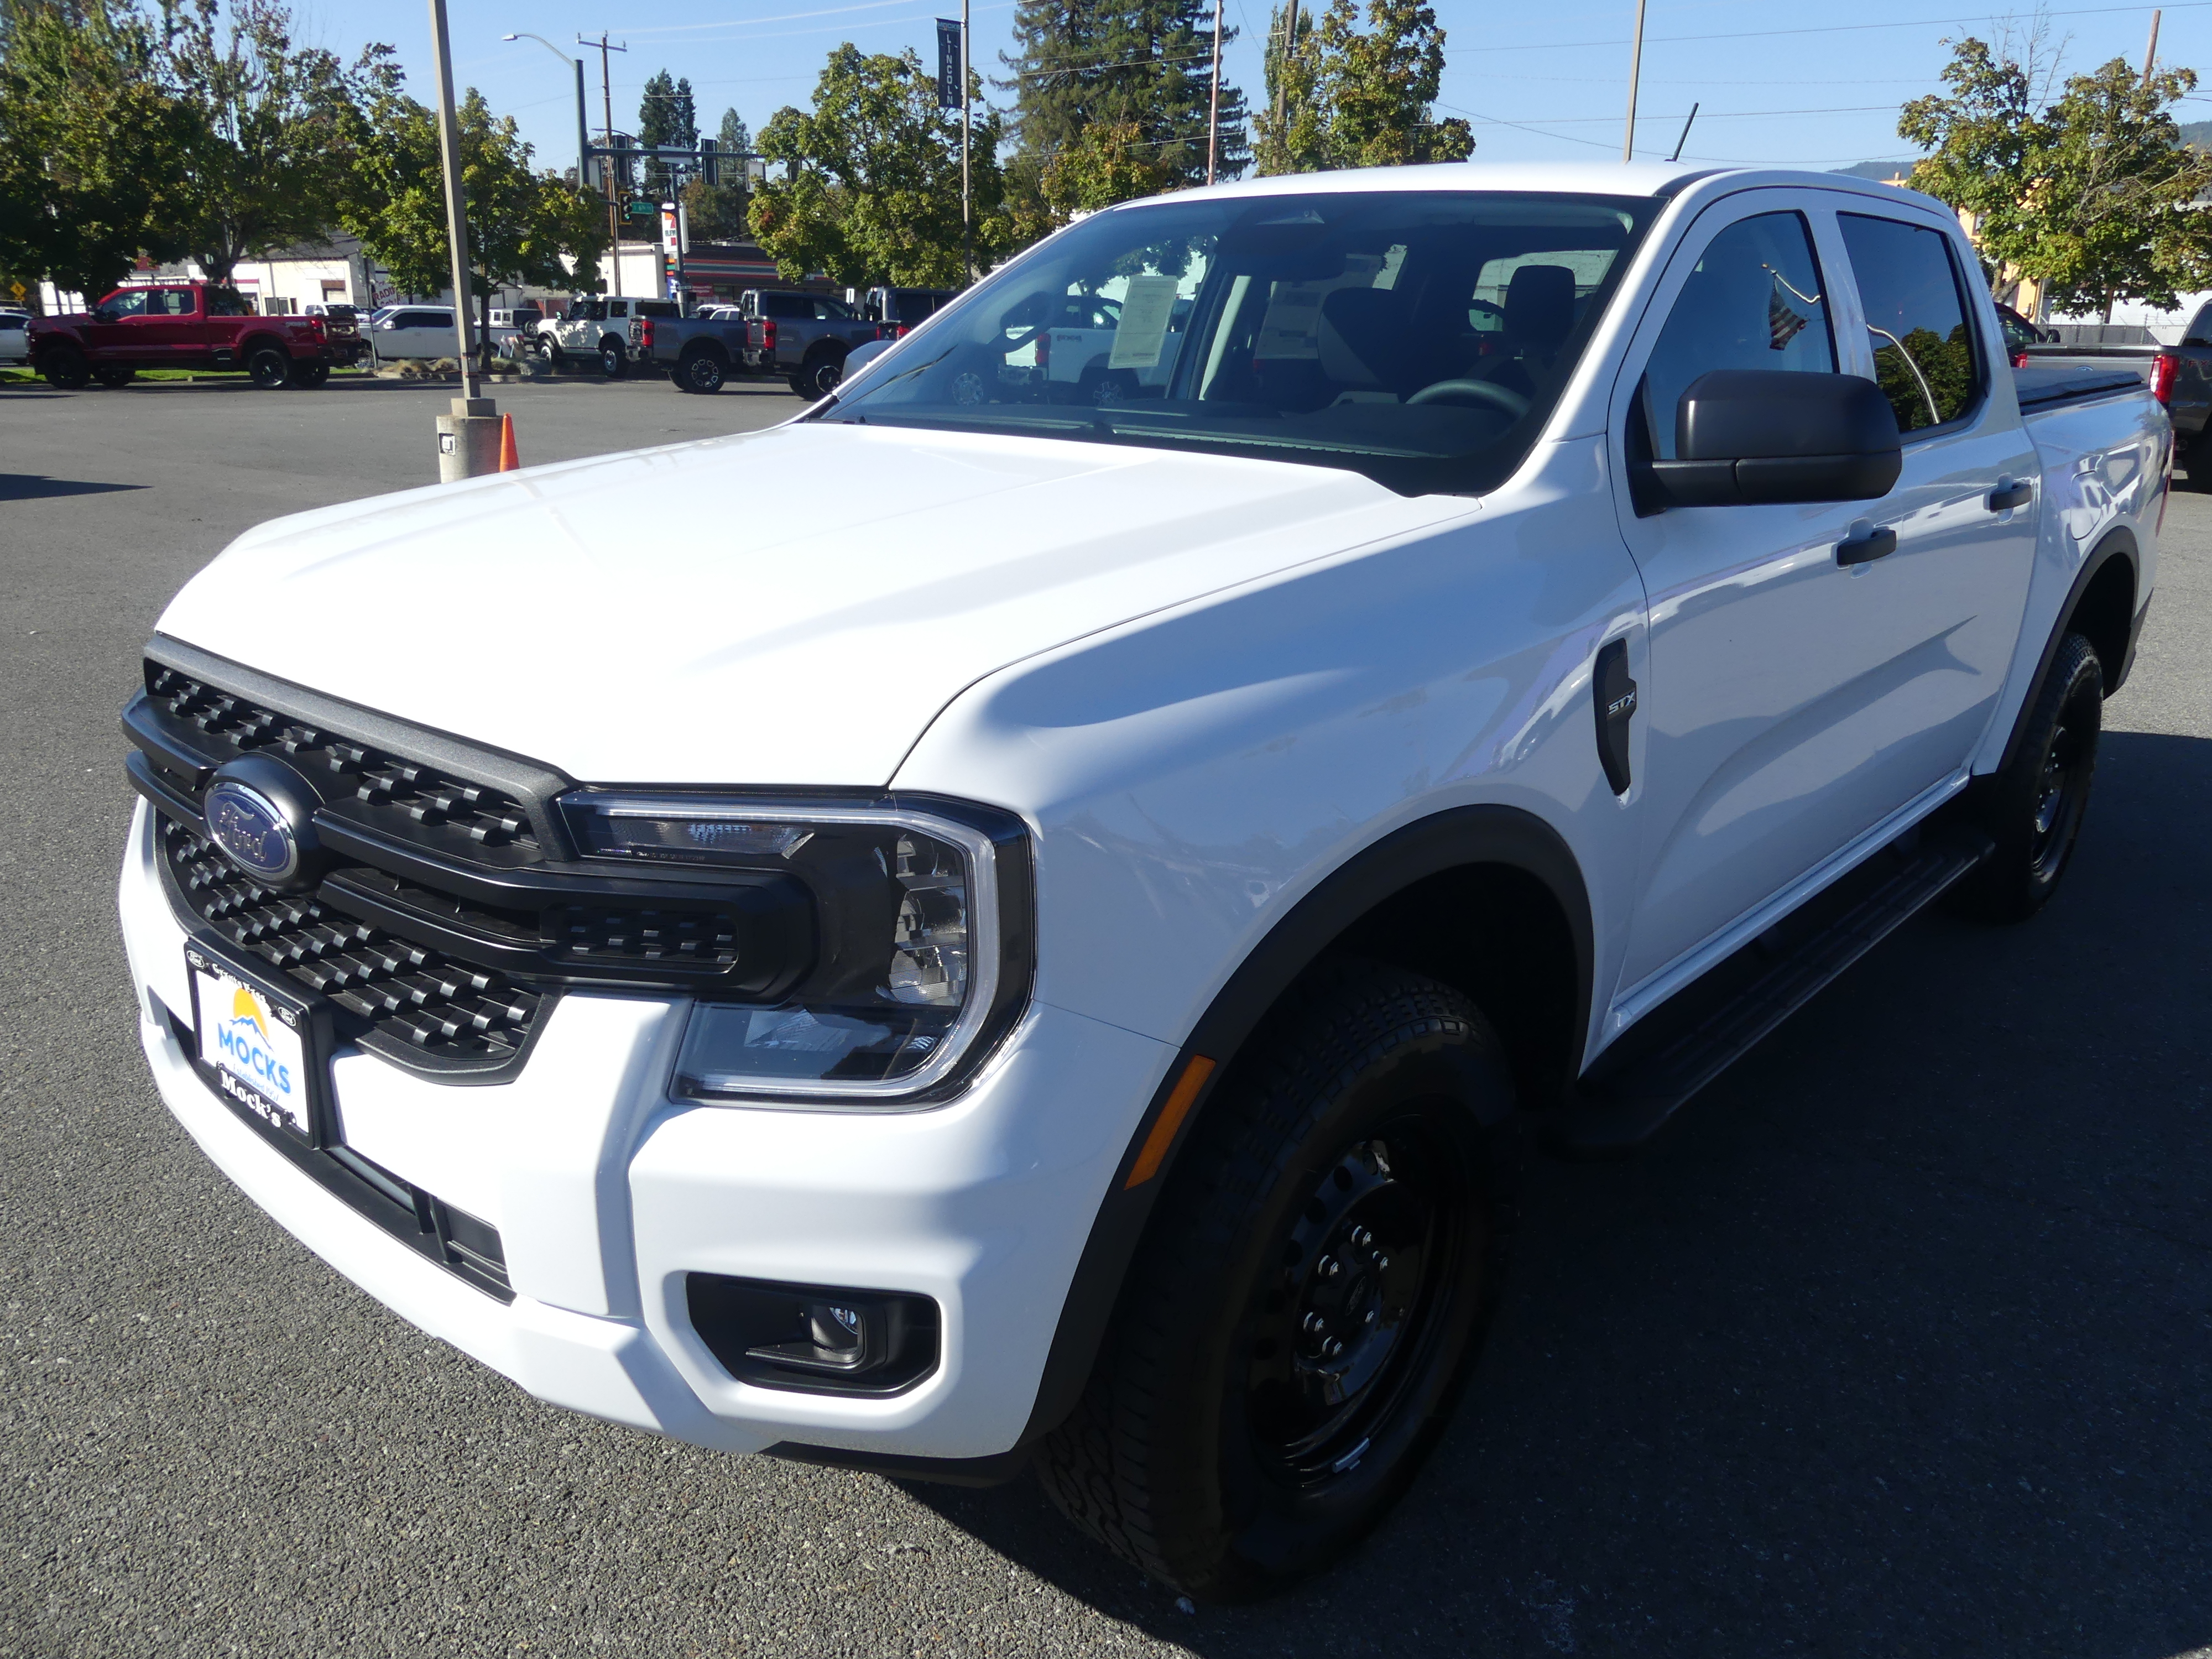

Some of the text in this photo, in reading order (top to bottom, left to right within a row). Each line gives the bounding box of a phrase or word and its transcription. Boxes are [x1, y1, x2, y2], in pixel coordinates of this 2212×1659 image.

[1608, 691, 1635, 715] STX
[219, 800, 267, 862] Ford
[218, 1022, 291, 1094] MOCKS
[221, 1069, 282, 1128] Mock's
